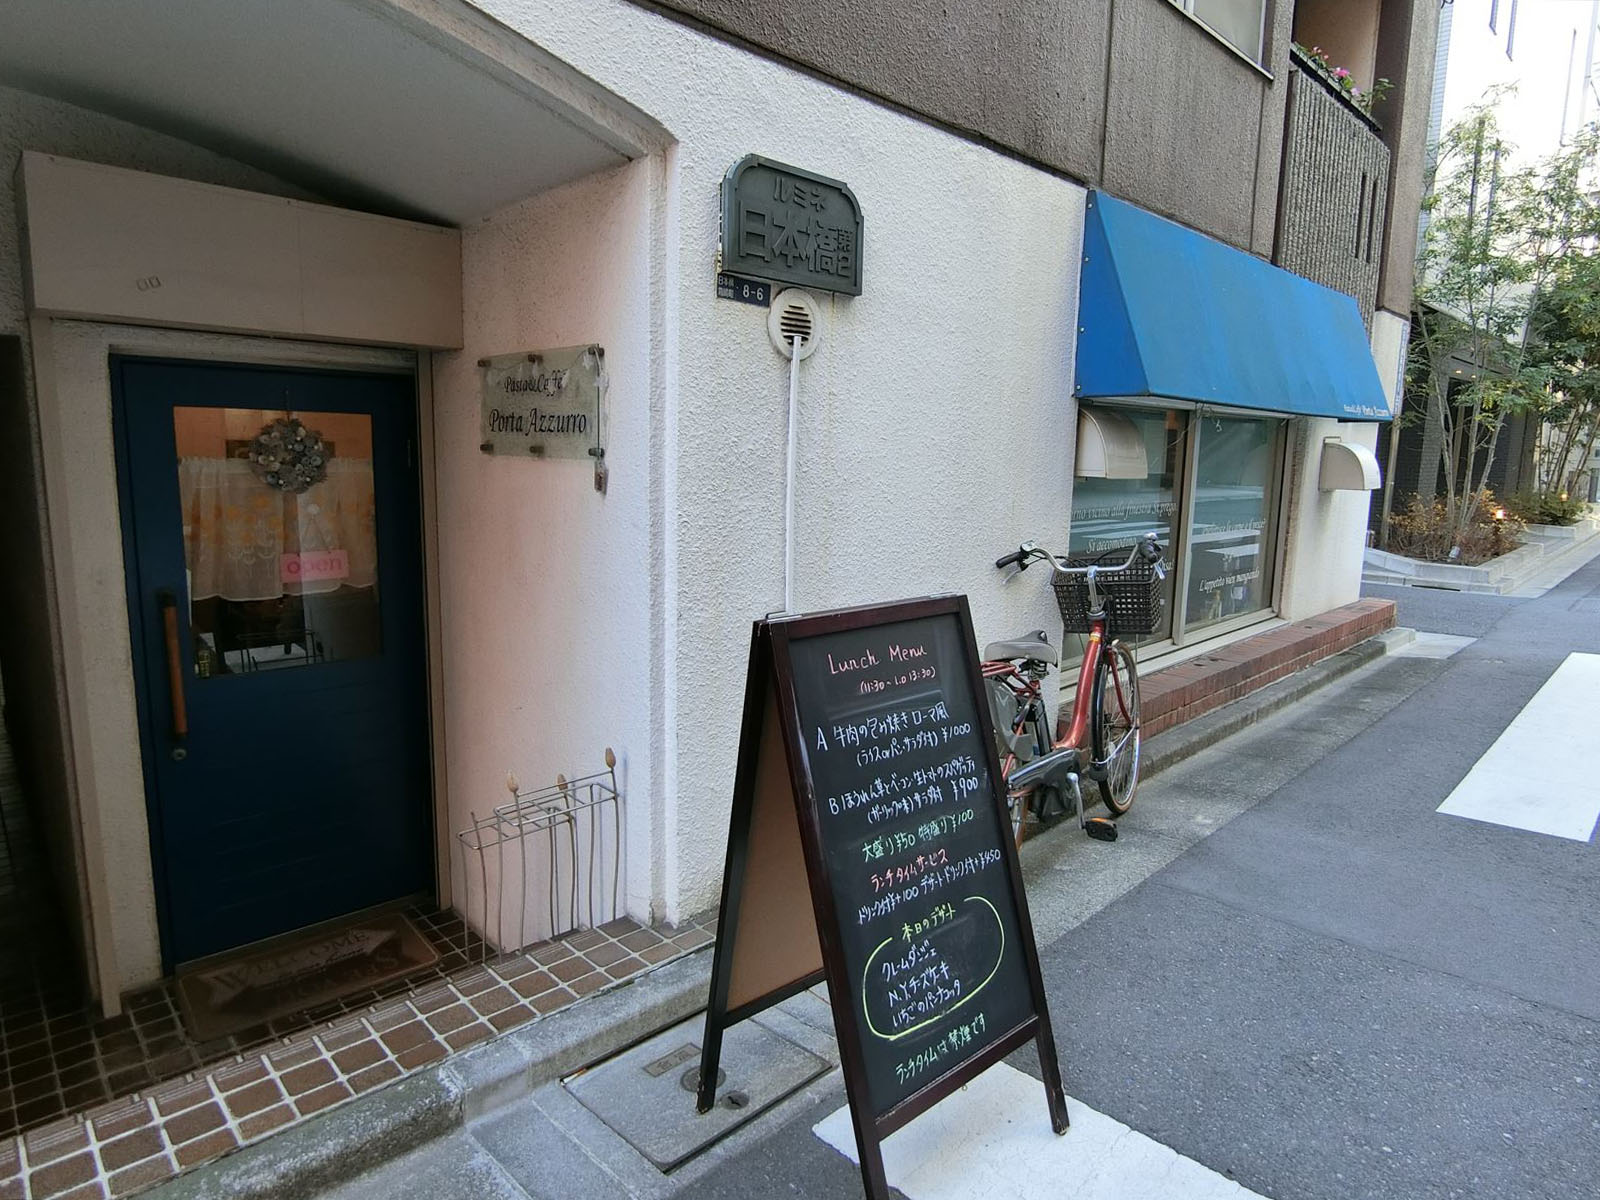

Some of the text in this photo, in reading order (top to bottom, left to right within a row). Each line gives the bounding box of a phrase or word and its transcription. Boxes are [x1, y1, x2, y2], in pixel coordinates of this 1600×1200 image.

[773, 175, 825, 212] ルミネ
[742, 283, 764, 302] 8-6
[489, 407, 587, 436] Porta Azzurro
[827, 643, 928, 676] Lunch Menu
[816, 726, 828, 752] A
[828, 797, 840, 816] B
